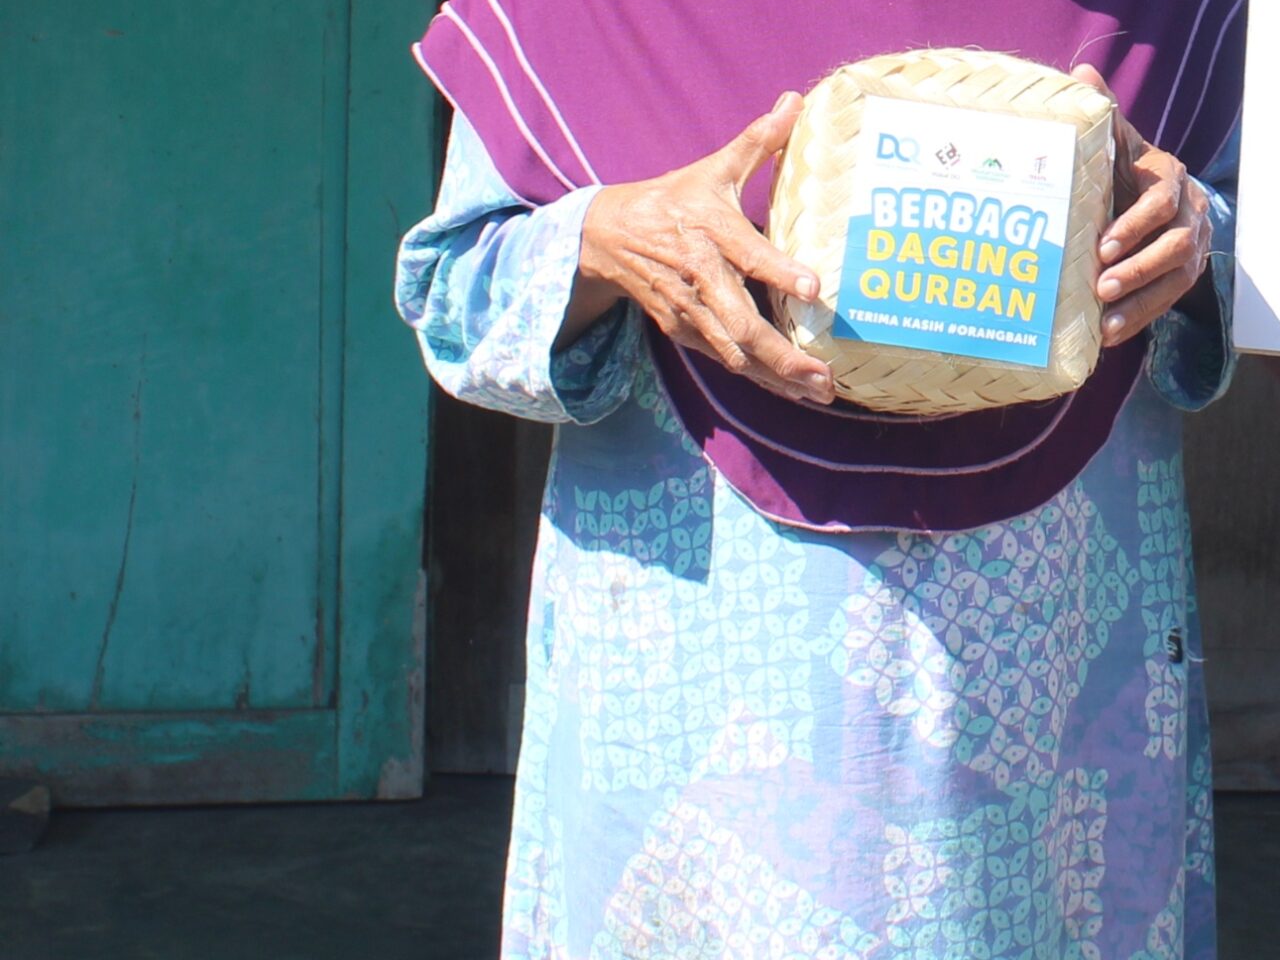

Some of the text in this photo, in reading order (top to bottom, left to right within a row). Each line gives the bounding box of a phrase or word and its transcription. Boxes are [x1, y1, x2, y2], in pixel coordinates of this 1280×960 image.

[871, 187, 1048, 250] BERBAGI
[866, 229, 1040, 284] DAGING
[859, 268, 1037, 321] QURBAN
[848, 308, 1037, 347] TERIMA KASIH #ORANGBAIK
